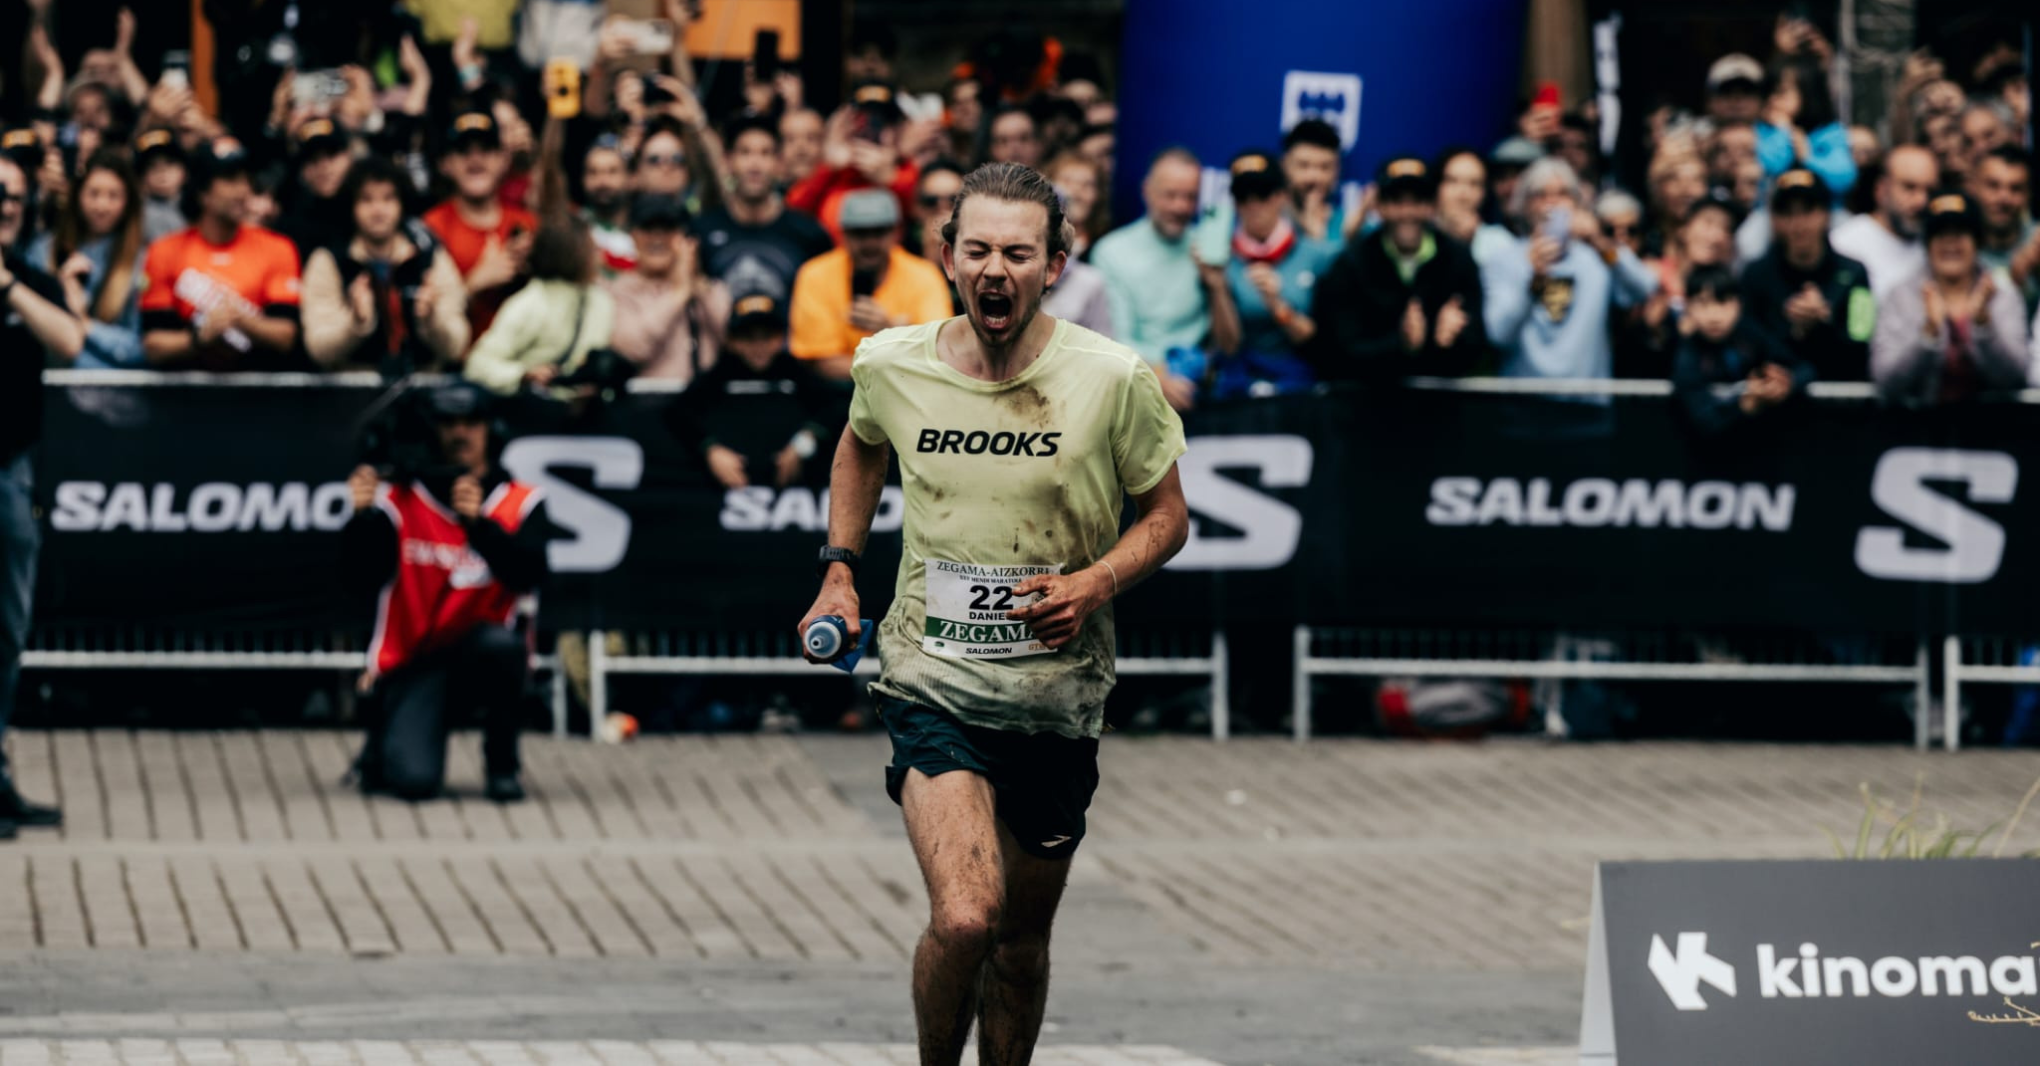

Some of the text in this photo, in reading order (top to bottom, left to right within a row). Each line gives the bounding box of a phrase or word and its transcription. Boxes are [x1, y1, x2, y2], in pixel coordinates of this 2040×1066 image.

[916, 428, 1062, 457] BROOKS
[51, 481, 353, 531] SALOMO
[1426, 477, 1796, 531] SALOMON
[1854, 447, 2018, 583] S
[969, 585, 1013, 610] 22
[969, 611, 1006, 620] DANIE
[940, 620, 1033, 642] ZEGAM
[1757, 942, 2040, 998] kinoma
